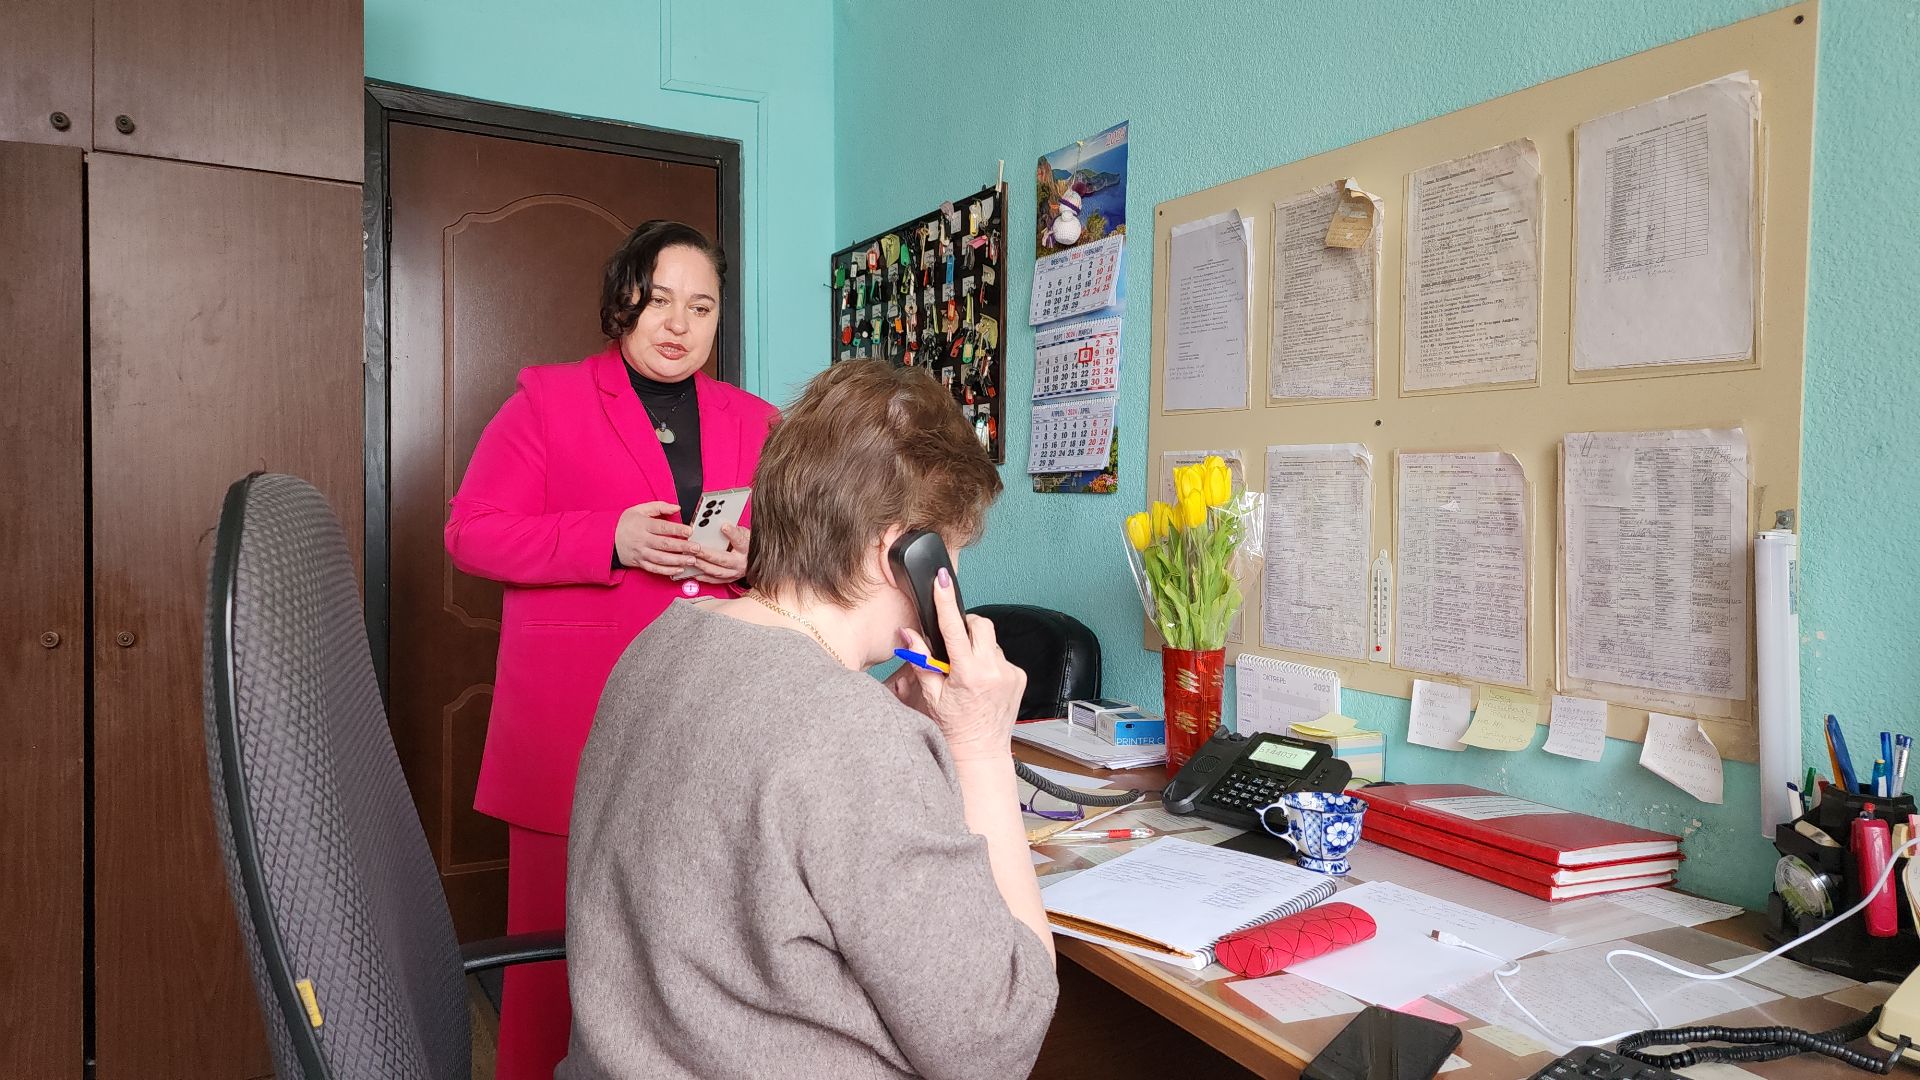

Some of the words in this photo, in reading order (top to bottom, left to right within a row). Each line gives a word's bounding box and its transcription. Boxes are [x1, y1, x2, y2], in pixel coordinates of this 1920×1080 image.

[1262, 674, 1286, 685] ОКТЯБРЬ
[1313, 683, 1330, 692] 2023
[1116, 737, 1154, 745] PRINTER
